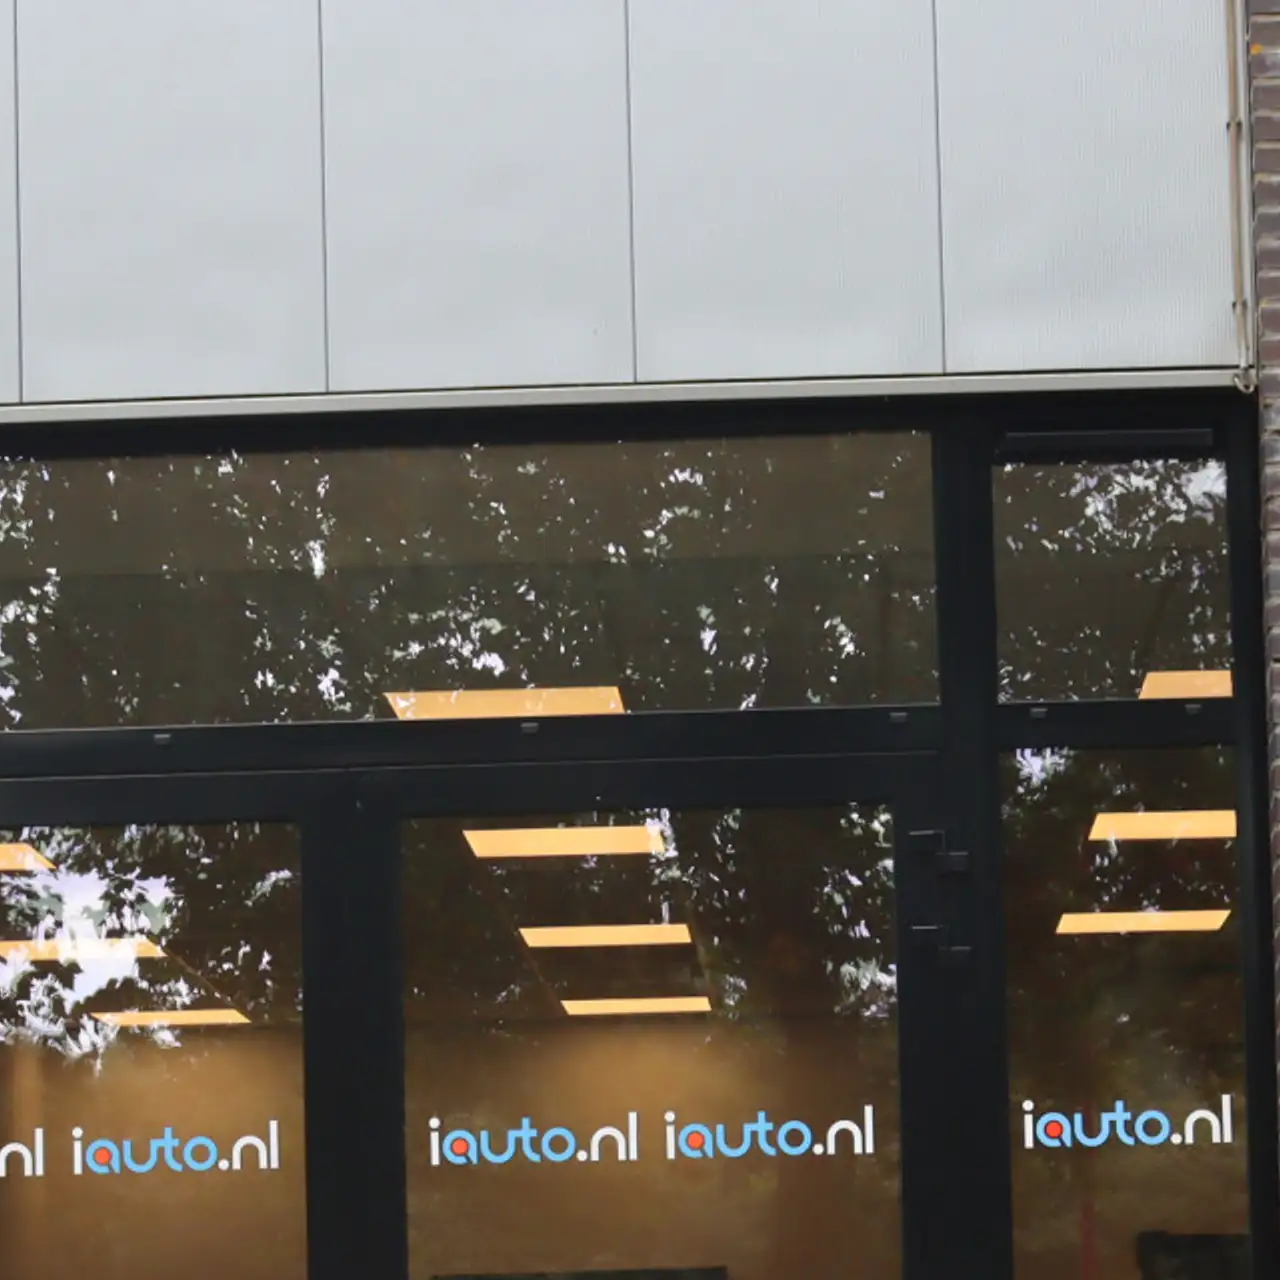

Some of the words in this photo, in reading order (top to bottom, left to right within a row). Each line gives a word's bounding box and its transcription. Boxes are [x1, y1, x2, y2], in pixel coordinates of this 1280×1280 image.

[71, 1119, 279, 1176] iauto.nl
[428, 1111, 638, 1166] iauto.nl
[663, 1105, 874, 1160] iauto.nl
[1022, 1094, 1232, 1149] iauto.nl
